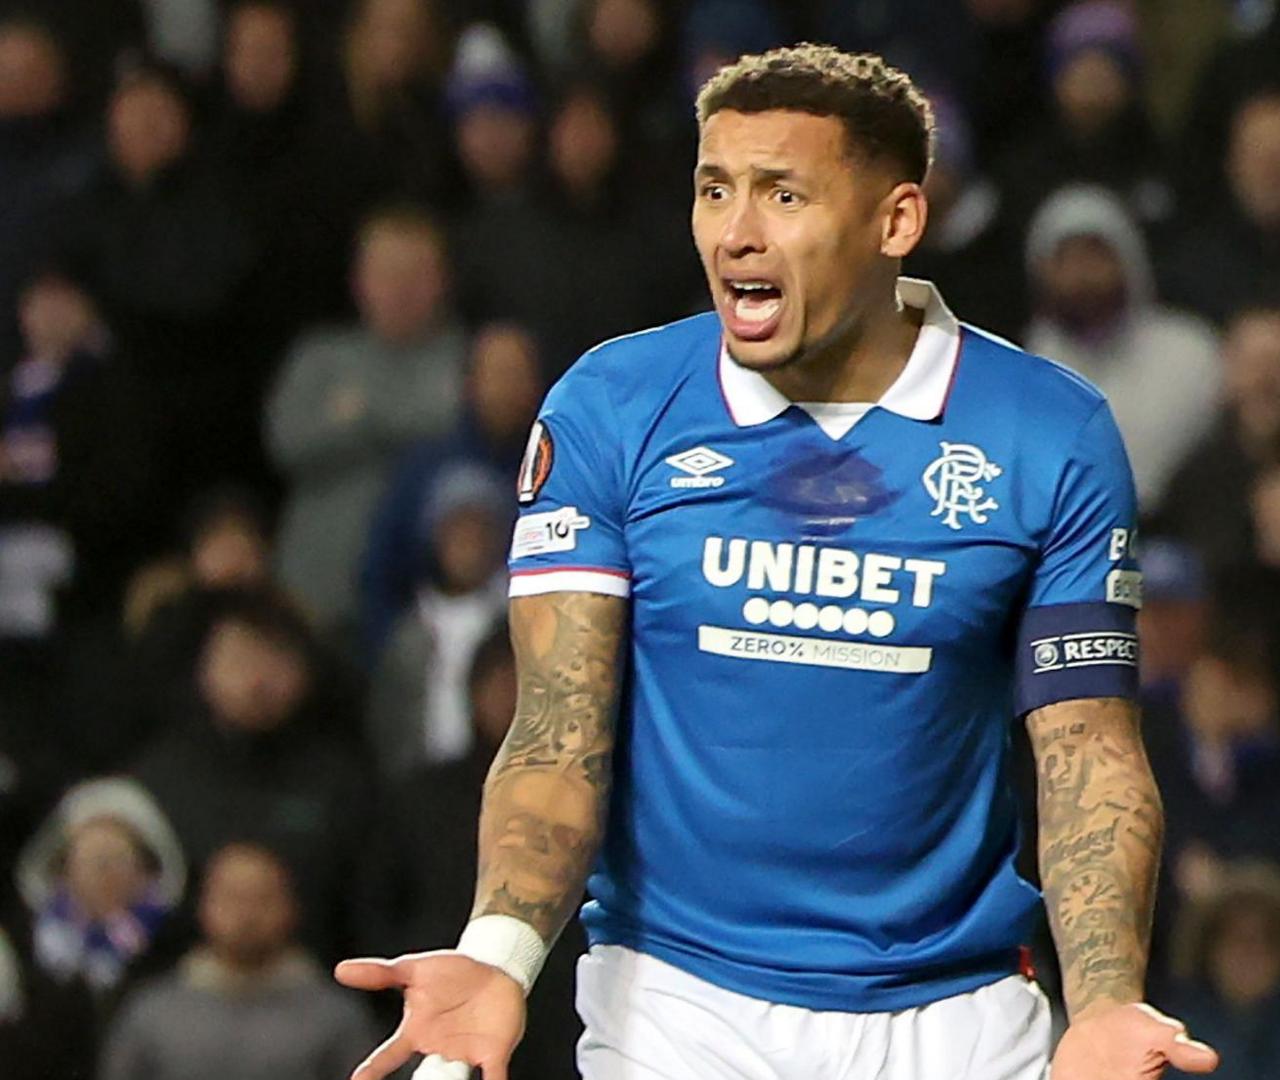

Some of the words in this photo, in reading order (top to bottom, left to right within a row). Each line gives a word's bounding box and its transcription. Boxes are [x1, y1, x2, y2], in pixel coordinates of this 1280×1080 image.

[702, 536, 946, 608] UNIBET
[730, 636, 805, 657] ZERO%
[811, 644, 901, 667] MISSION
[1063, 638, 1138, 661] RESPEC
